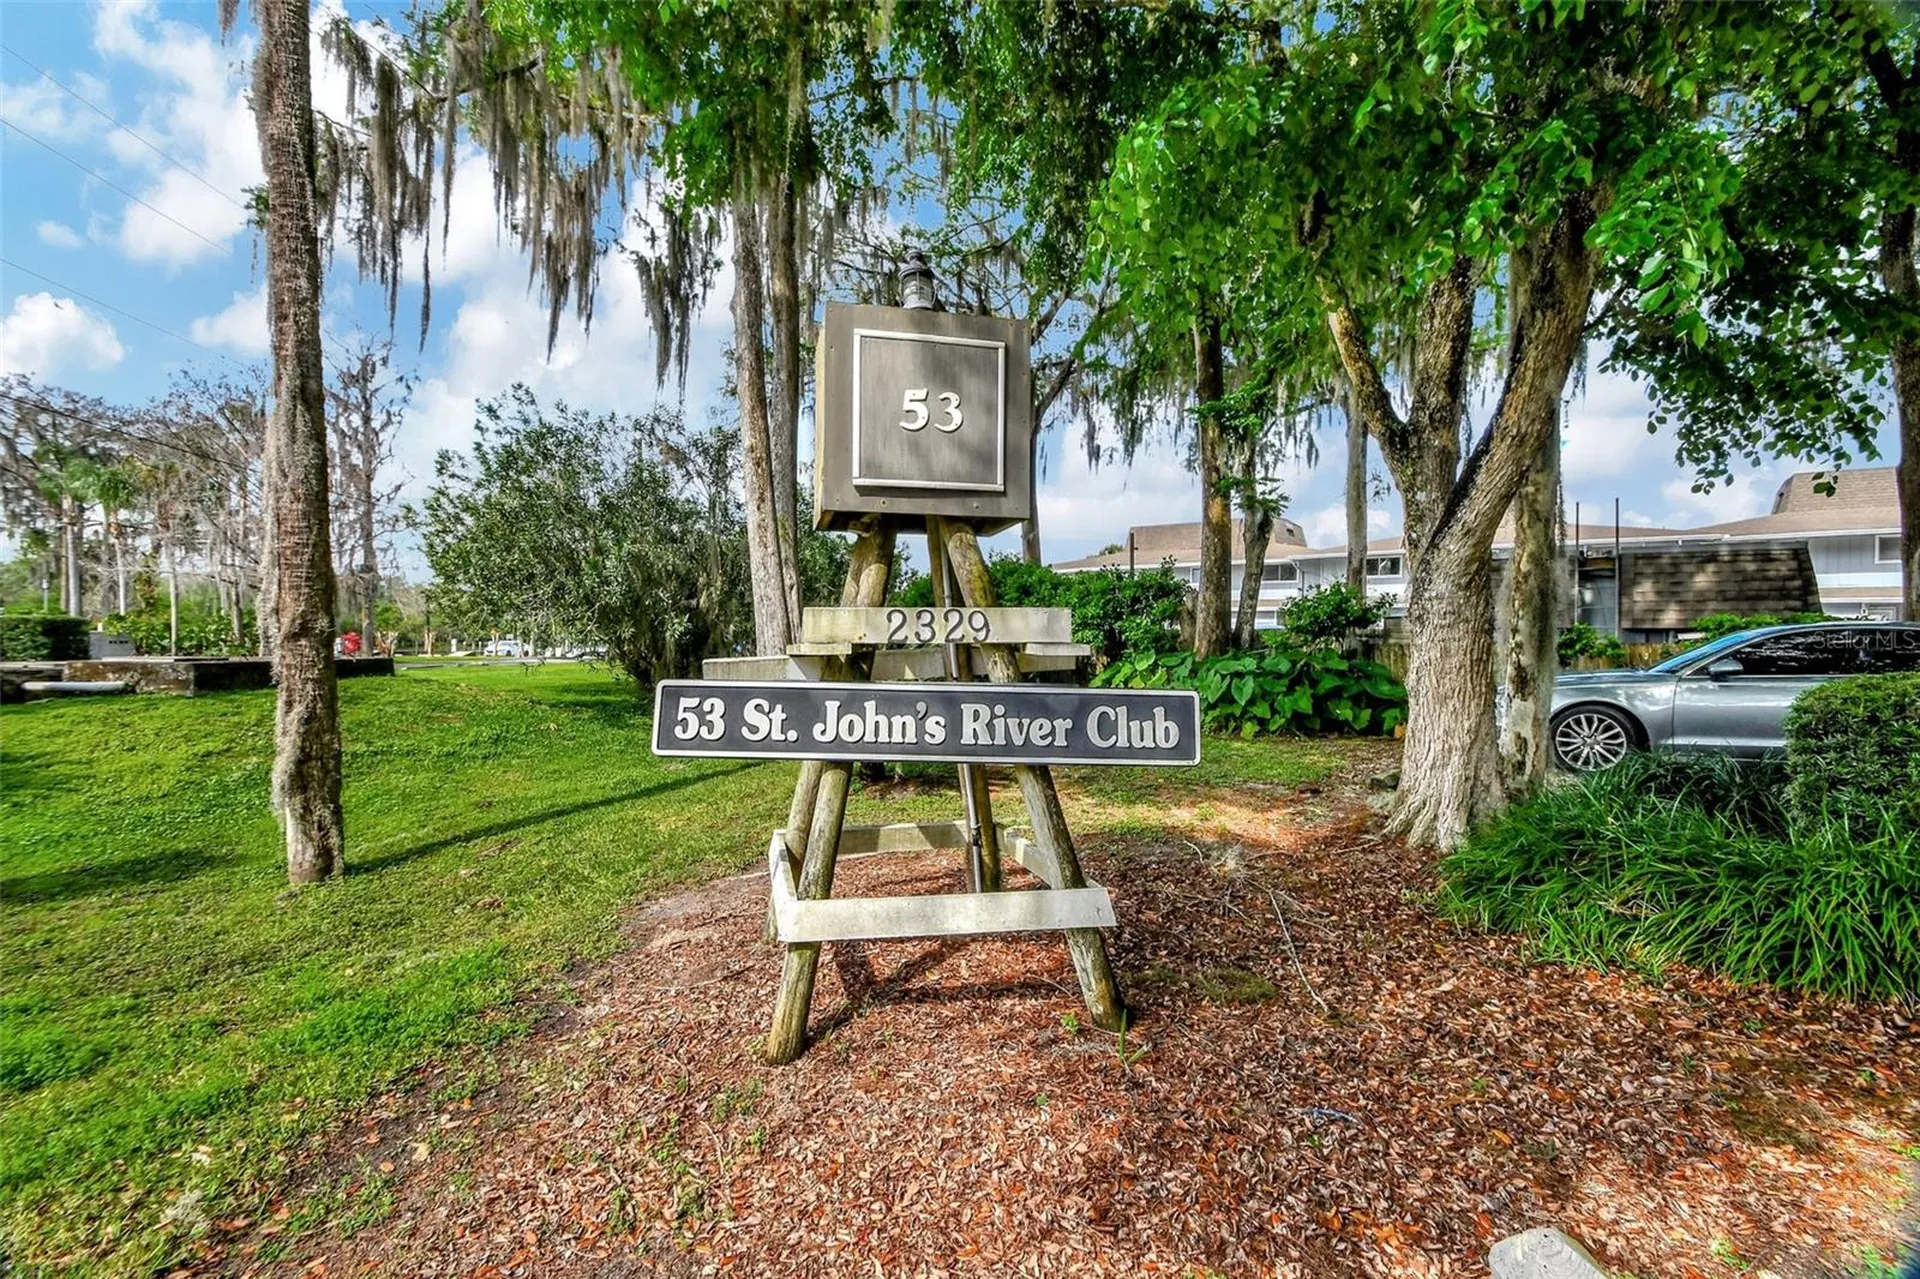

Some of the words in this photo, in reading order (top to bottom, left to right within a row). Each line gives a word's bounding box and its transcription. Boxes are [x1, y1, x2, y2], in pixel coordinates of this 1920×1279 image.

[899, 387, 964, 433] 53
[886, 608, 990, 643] 2329
[674, 697, 726, 740] 53
[741, 698, 798, 742] St.
[812, 700, 946, 745] John's
[960, 703, 1073, 747] River
[1086, 705, 1180, 749] Club
